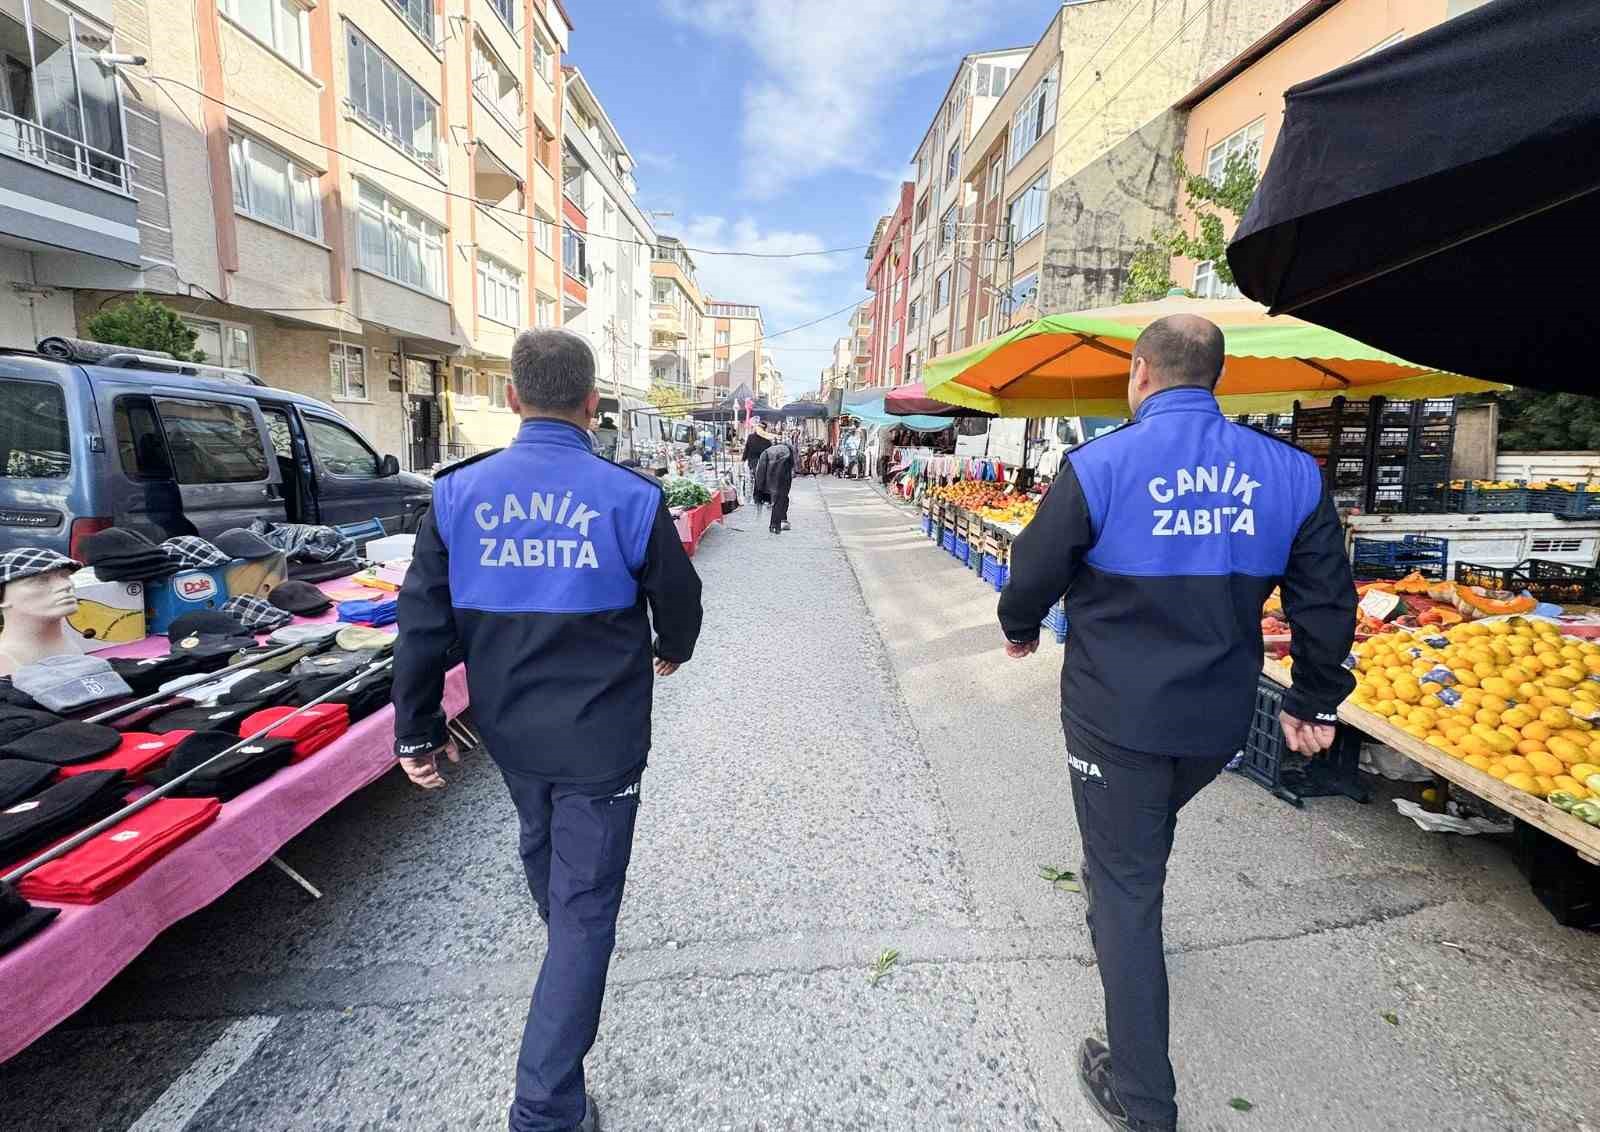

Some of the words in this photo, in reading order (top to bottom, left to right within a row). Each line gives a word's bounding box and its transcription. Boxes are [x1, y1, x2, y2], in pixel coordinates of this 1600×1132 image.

[1148, 460, 1263, 505] CANİK
[474, 490, 601, 537] CANİK
[1151, 506, 1256, 536] ZABITA
[479, 538, 600, 569] ZABITA
